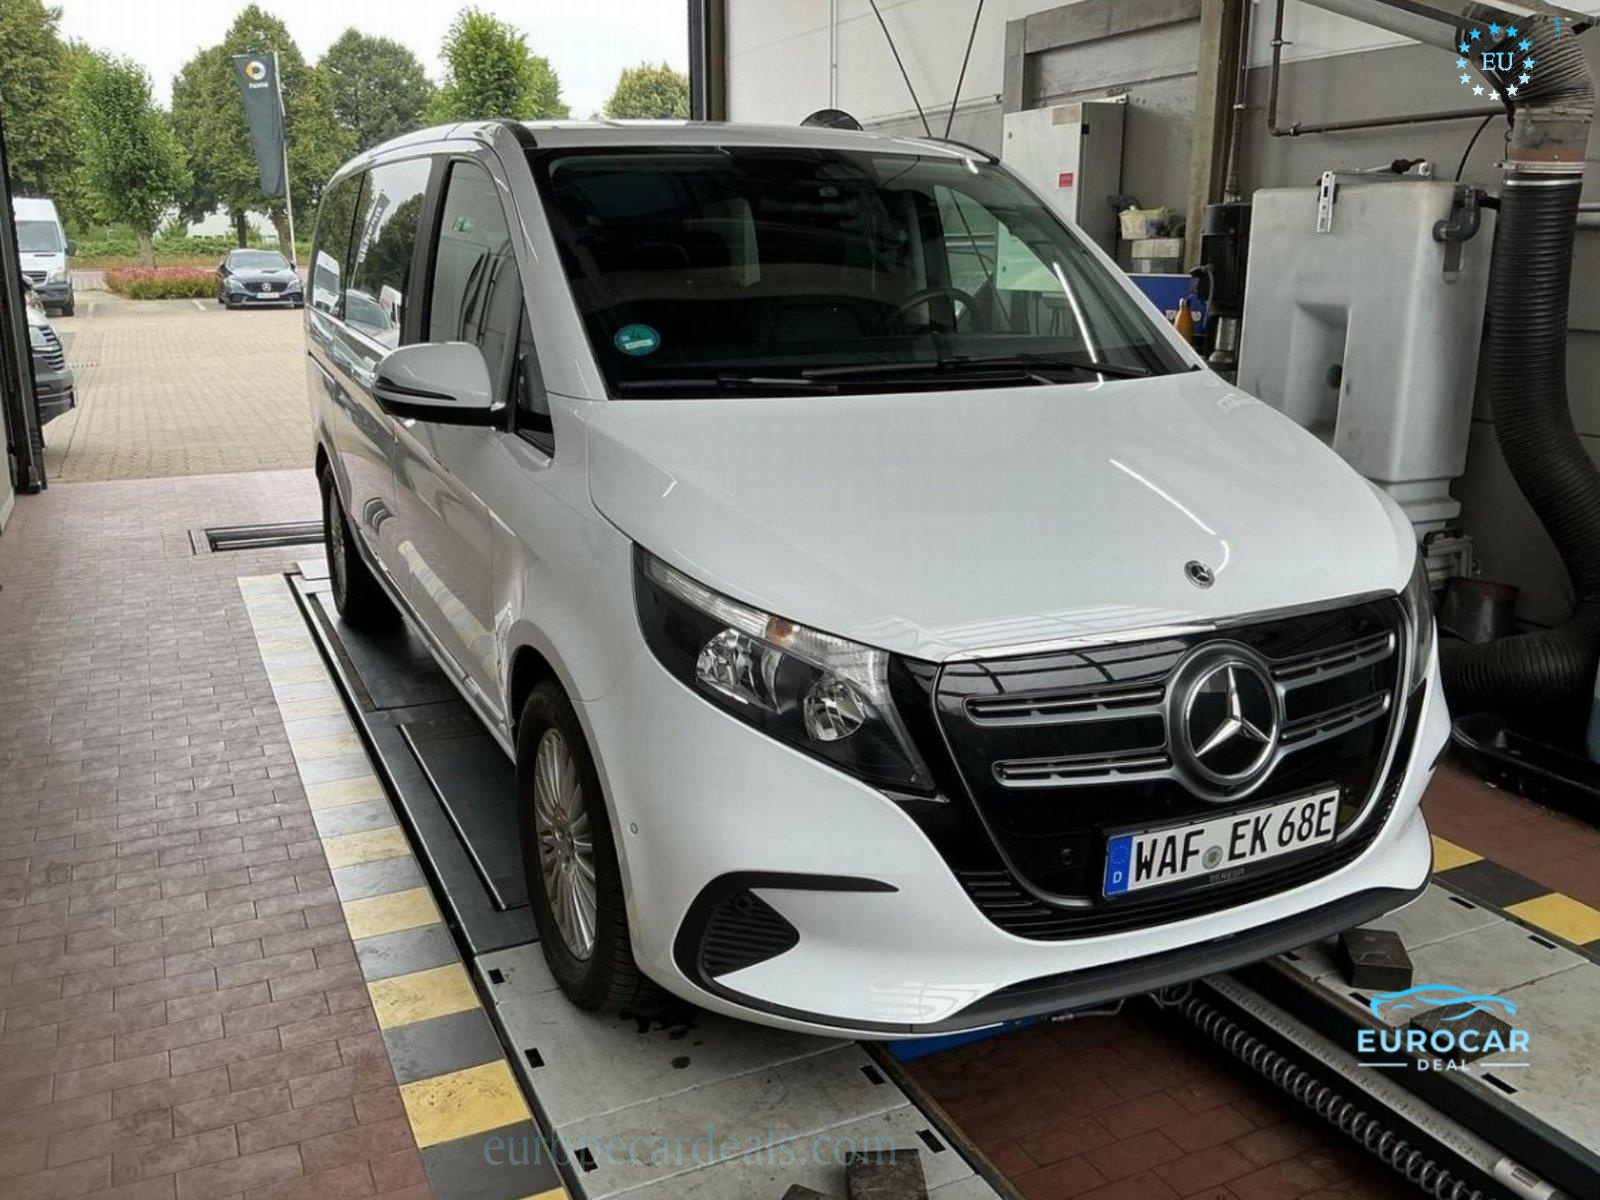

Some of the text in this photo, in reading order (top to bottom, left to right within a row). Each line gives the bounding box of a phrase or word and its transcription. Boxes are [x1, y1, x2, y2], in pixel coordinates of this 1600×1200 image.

[1135, 796, 1336, 882] WAF EK 68E
[1113, 870, 1123, 884] D
